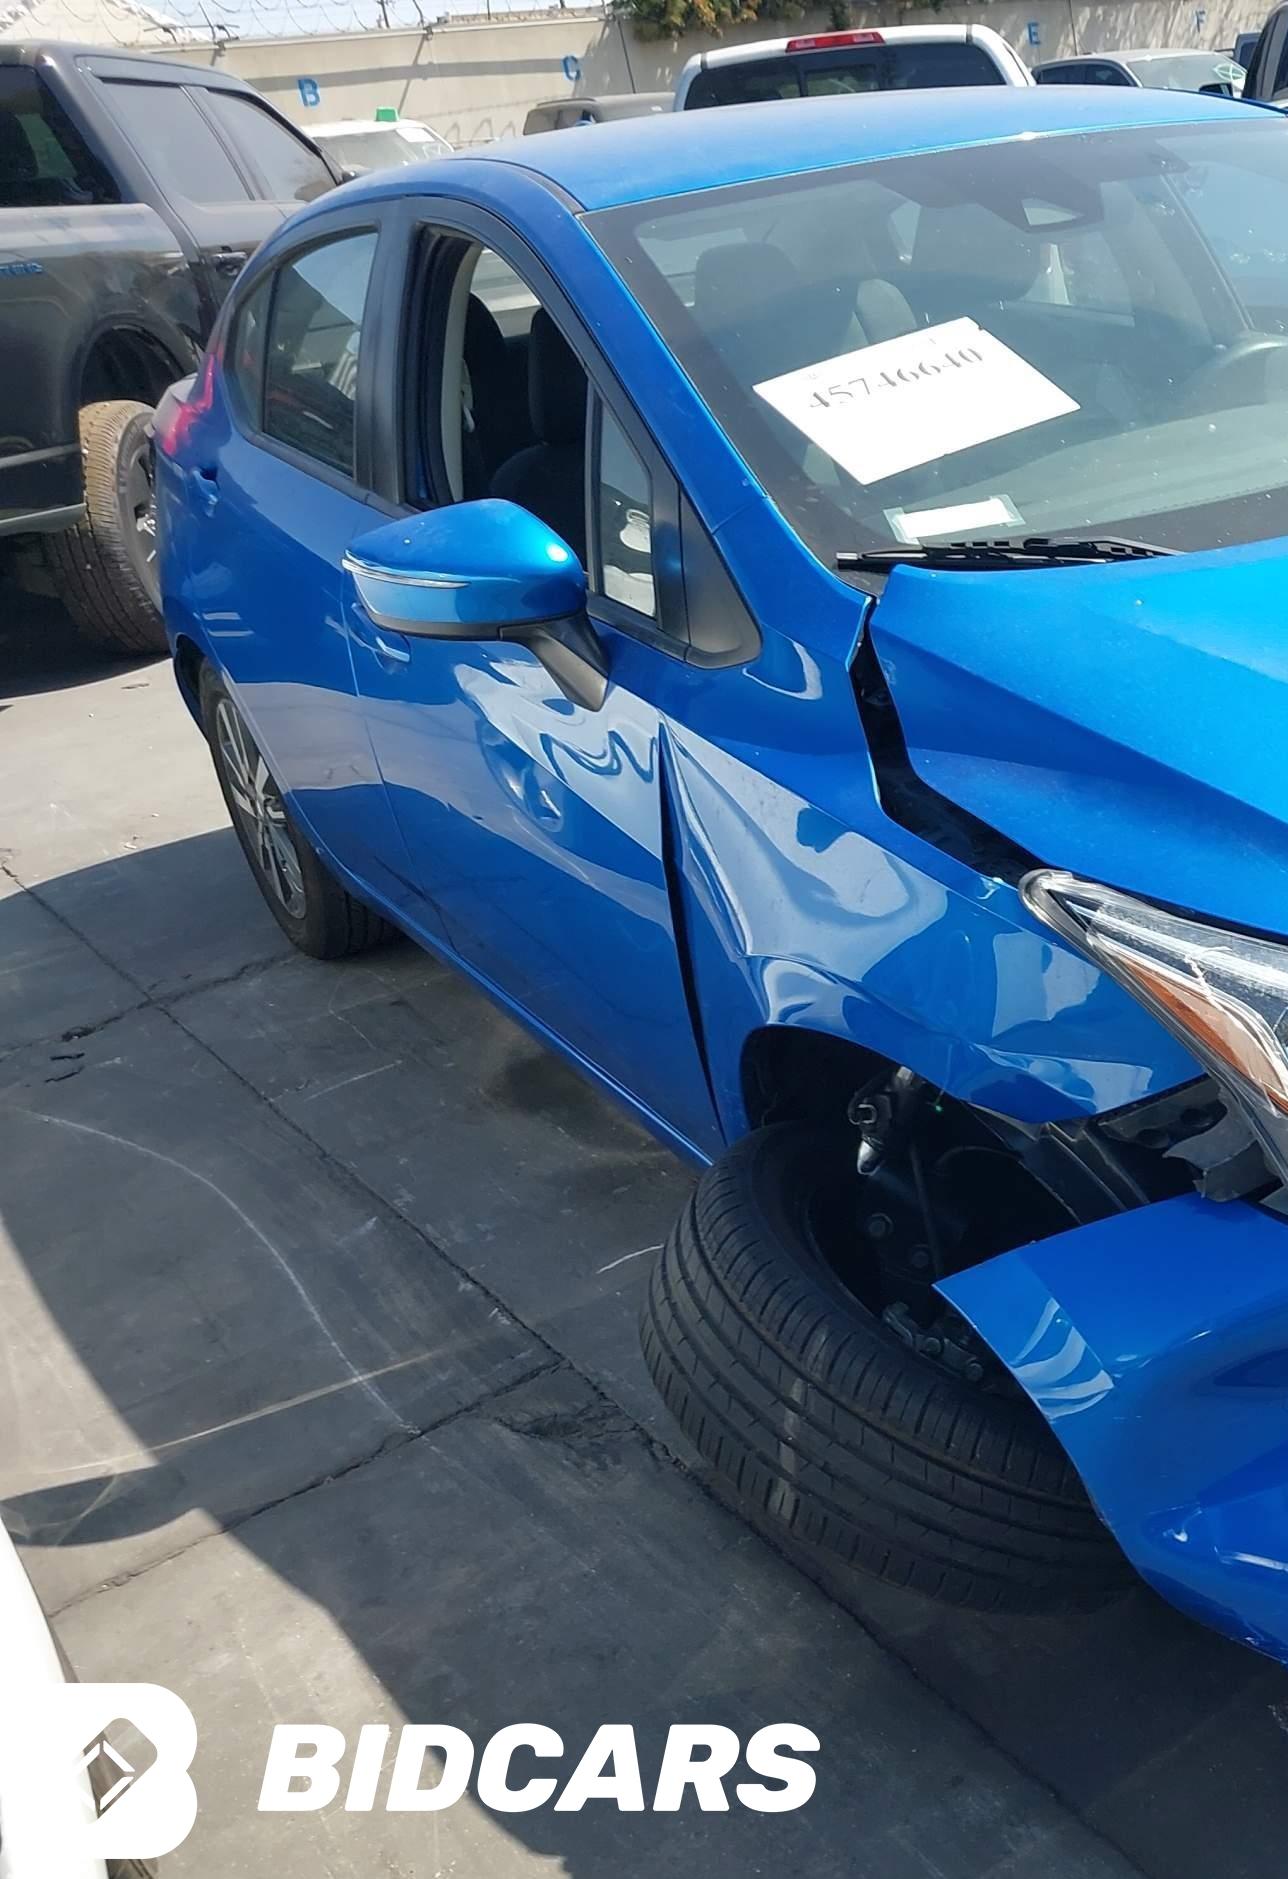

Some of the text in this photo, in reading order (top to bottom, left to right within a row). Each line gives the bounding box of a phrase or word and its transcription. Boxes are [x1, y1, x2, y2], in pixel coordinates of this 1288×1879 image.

[1027, 22, 1041, 45] E
[561, 55, 581, 82] C
[297, 78, 320, 107] B
[810, 348, 983, 407] 45746640
